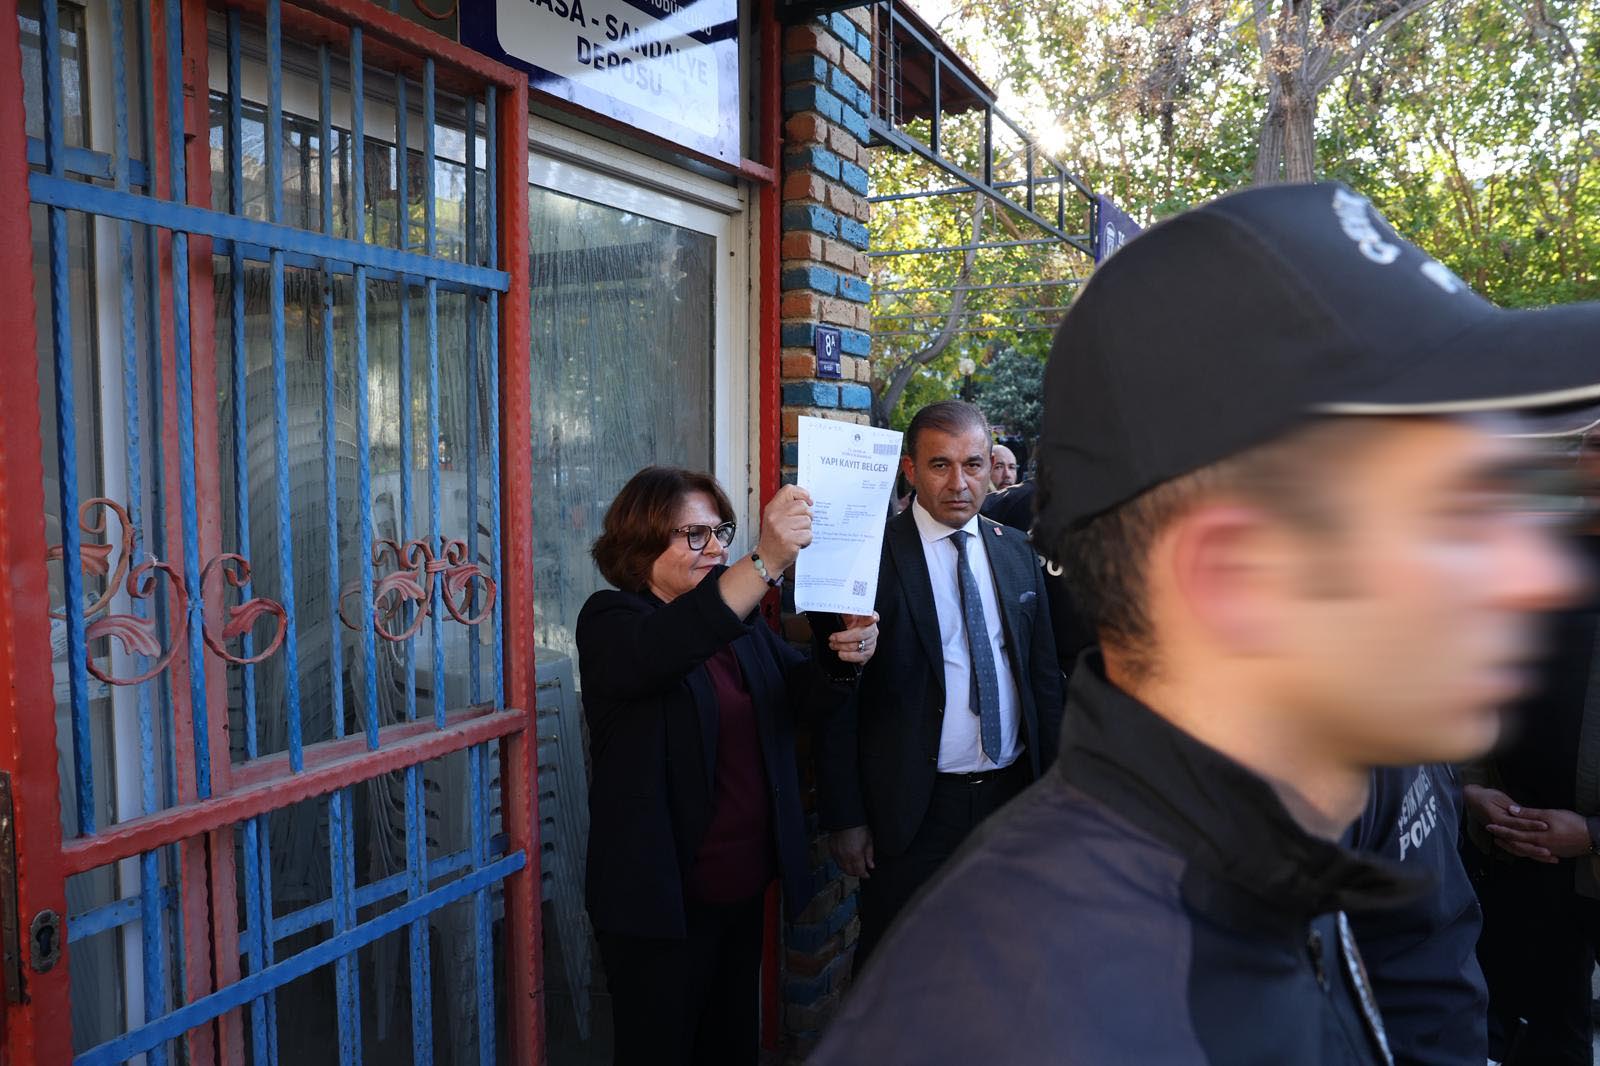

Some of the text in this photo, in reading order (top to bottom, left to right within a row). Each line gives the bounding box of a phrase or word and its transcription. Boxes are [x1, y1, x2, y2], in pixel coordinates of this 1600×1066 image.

[577, 35, 663, 96] DEPOSU
[605, 14, 708, 86] SANDALYE
[820, 456, 838, 467] YAPI
[839, 458, 861, 470] KAYIT
